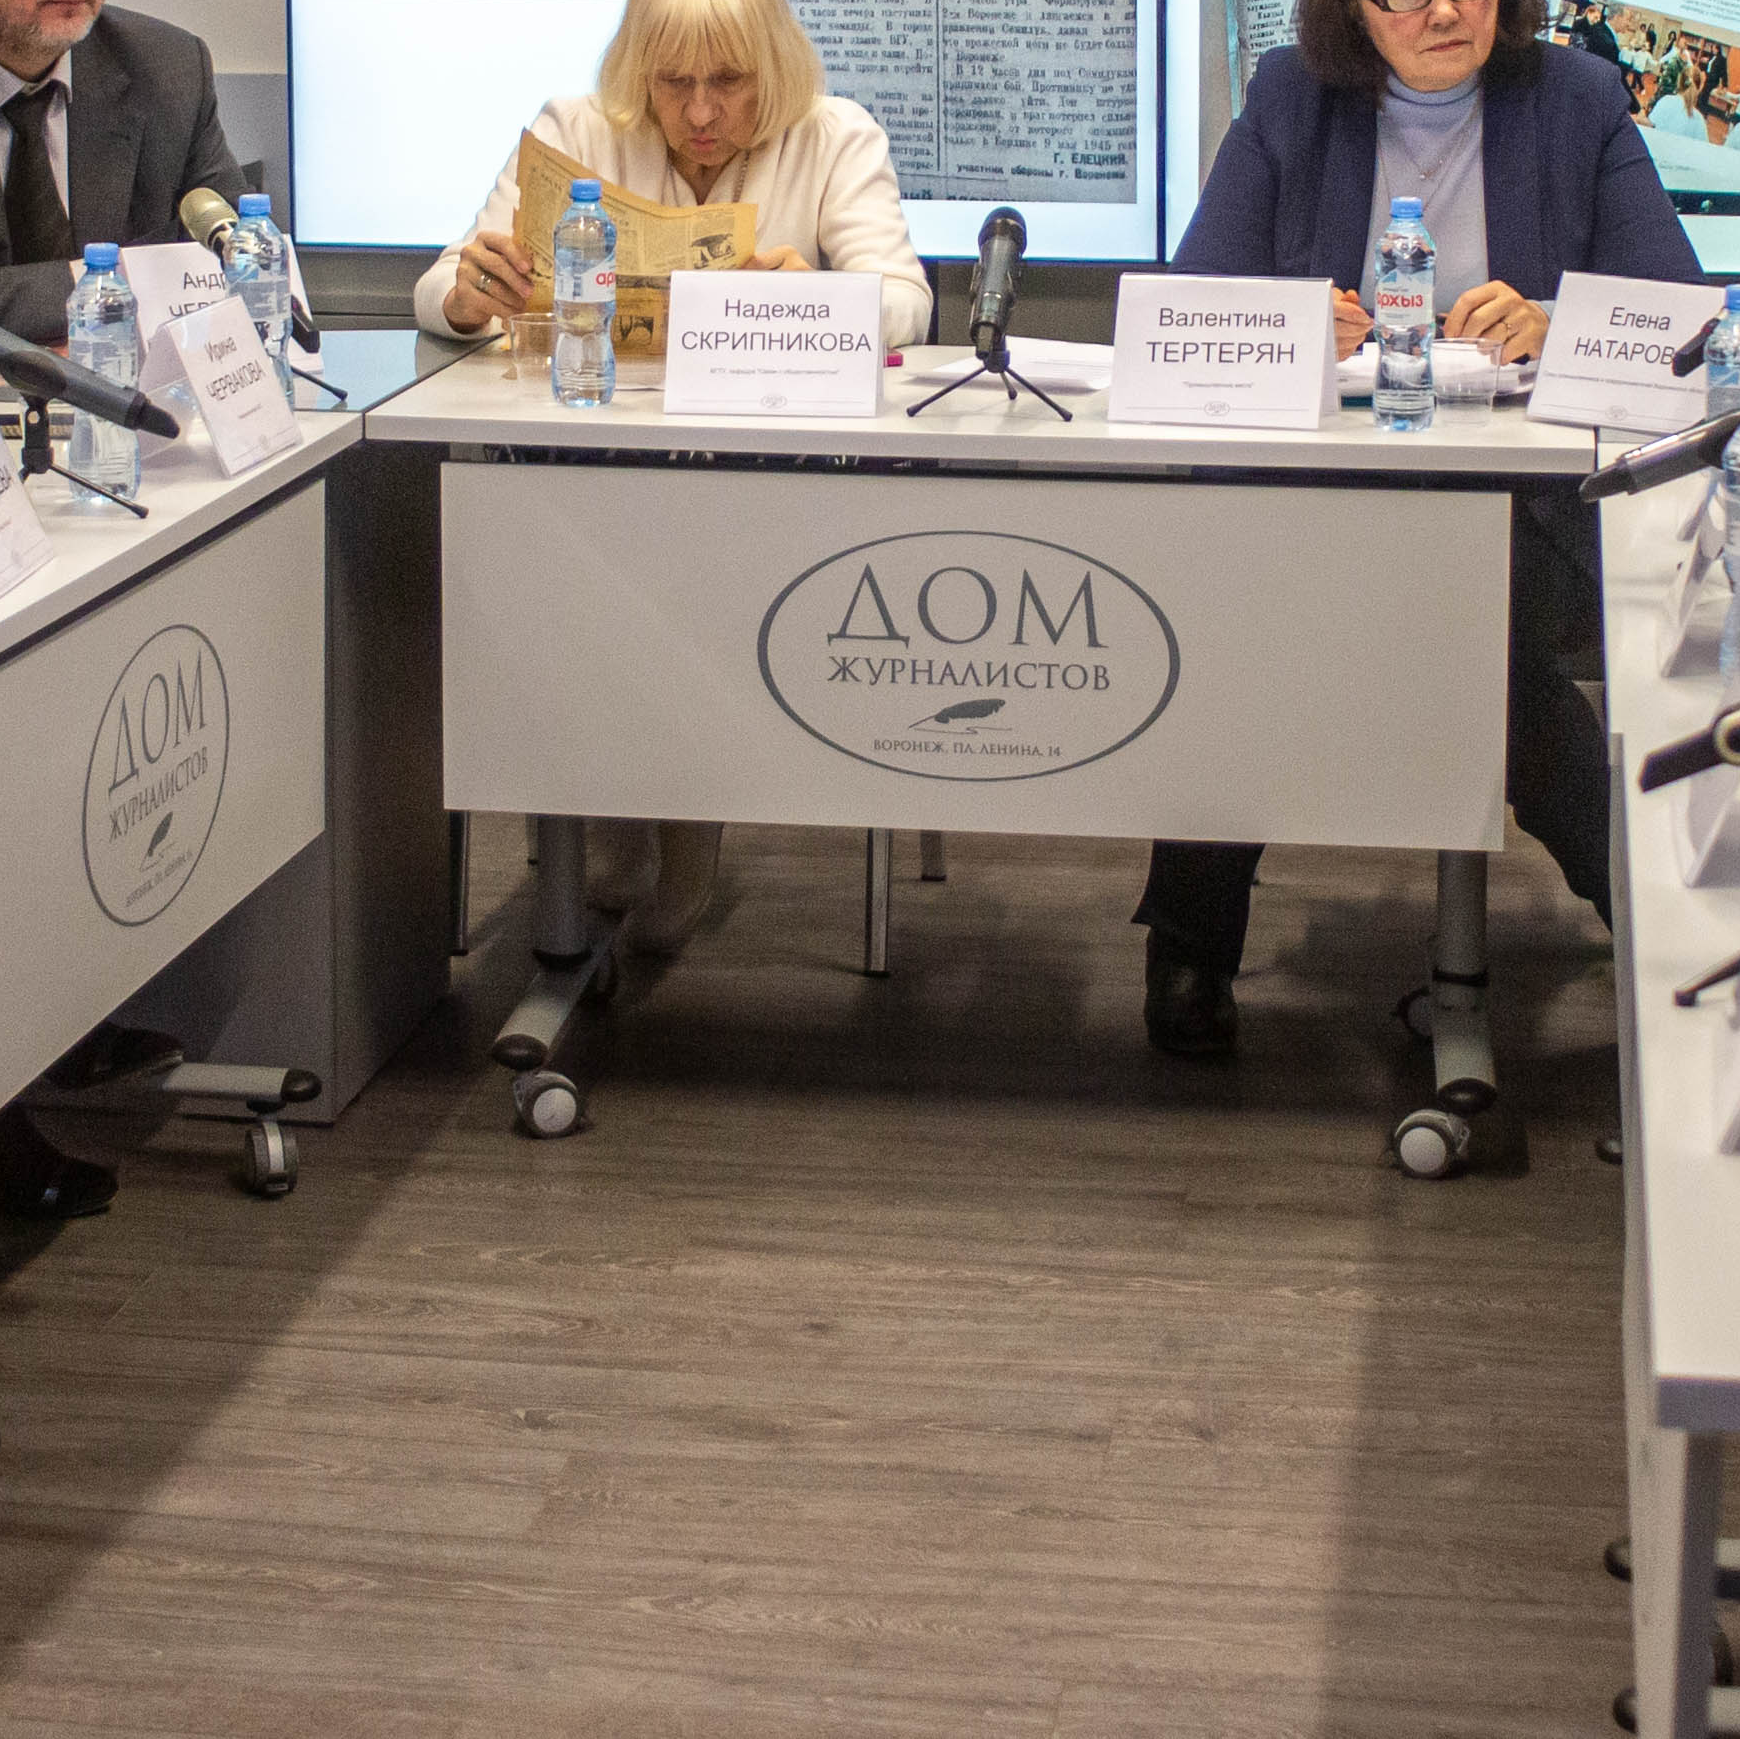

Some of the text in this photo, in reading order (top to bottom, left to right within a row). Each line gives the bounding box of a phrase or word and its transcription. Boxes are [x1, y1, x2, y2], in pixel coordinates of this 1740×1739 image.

[724, 299, 831, 321] Надежда
[1159, 308, 1286, 328] Валентина
[1609, 306, 1671, 331] Елена
[681, 331, 873, 352] СКРИПНИКОВА
[1146, 341, 1295, 364] ТЕРТЕРЯН
[827, 562, 1109, 649] ДОМ
[827, 656, 1111, 691] ЖУРНАЛИСТОВ
[107, 648, 207, 797] ДОМ
[109, 746, 209, 843] ЖУРНАЛИСТОВ
